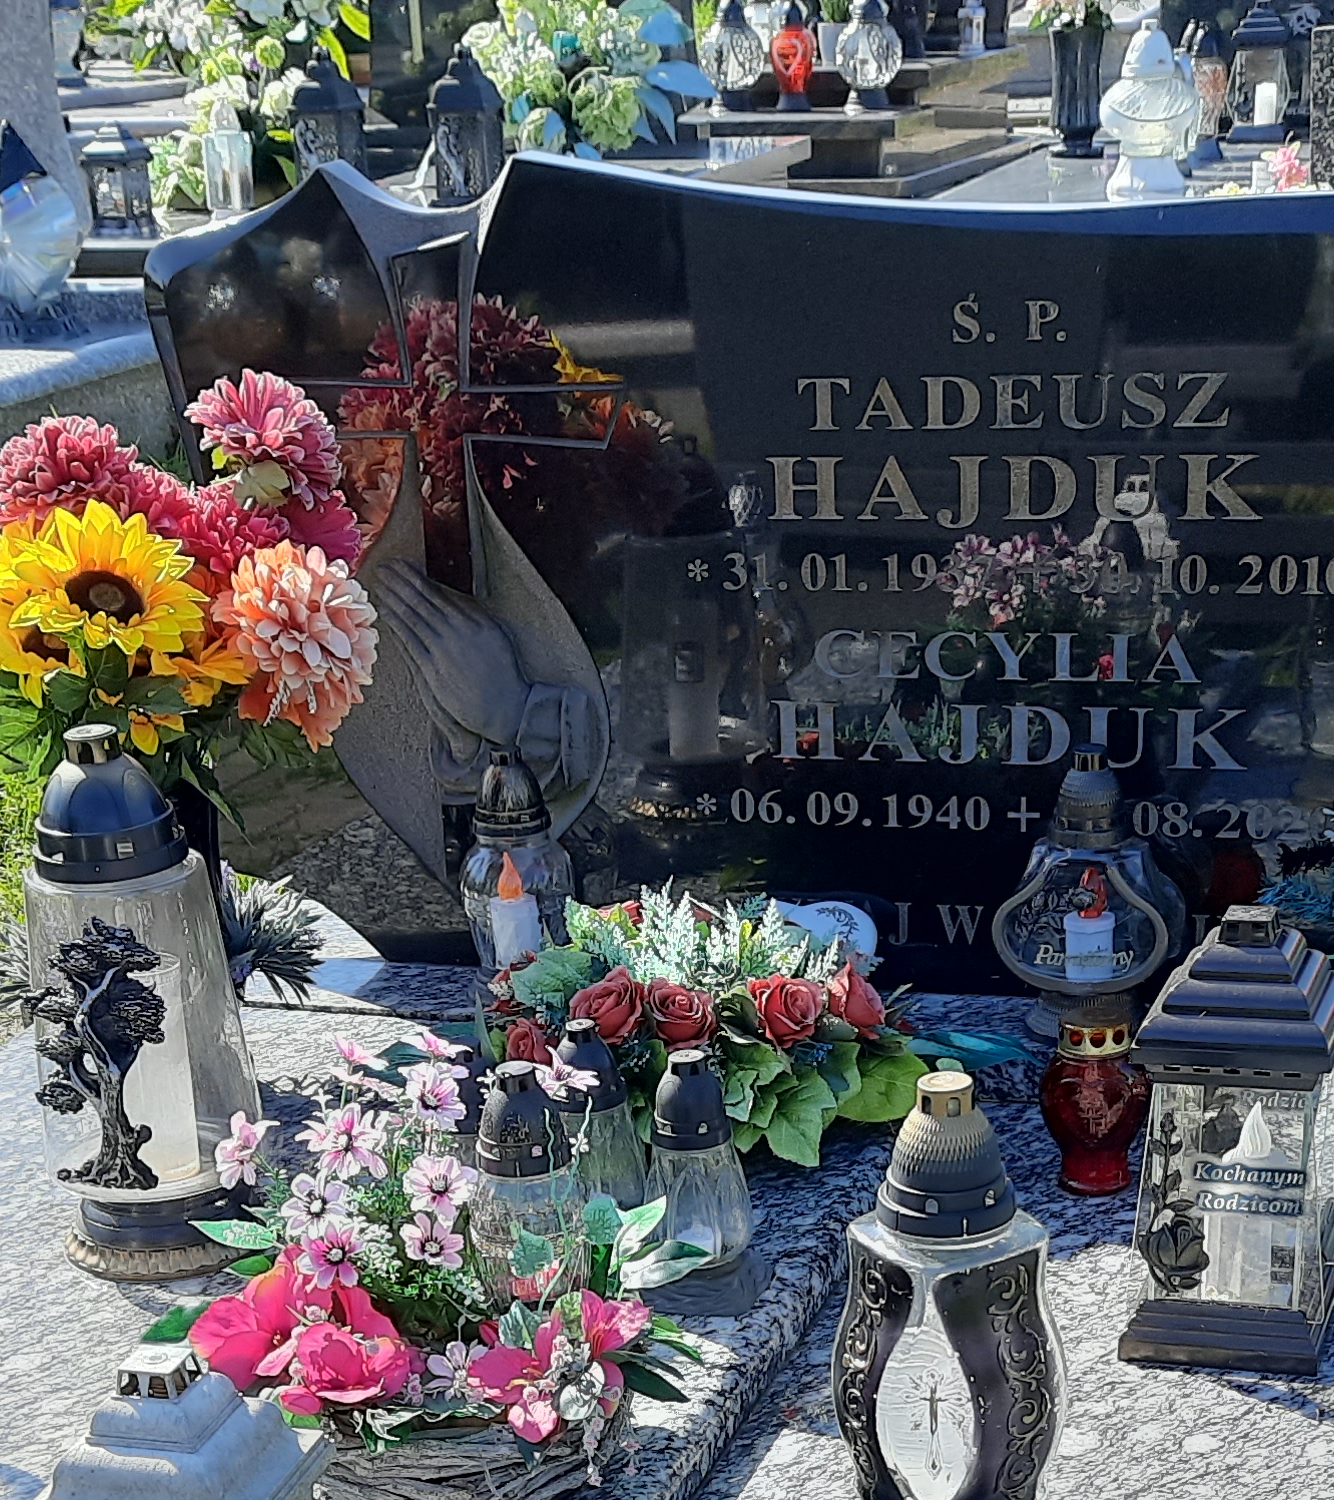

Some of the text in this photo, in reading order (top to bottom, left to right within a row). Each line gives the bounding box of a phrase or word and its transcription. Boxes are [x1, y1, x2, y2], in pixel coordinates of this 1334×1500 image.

[796, 371, 1231, 431] TADEUSZ
[765, 453, 1264, 529] HAJDUK
[816, 628, 1203, 685] CECYLIA
[770, 699, 1249, 771] HAJDUK
[936, 903, 985, 946] W
[1193, 1162, 1305, 1190] Kochanym
[1197, 1191, 1302, 1215] Rodzicom
